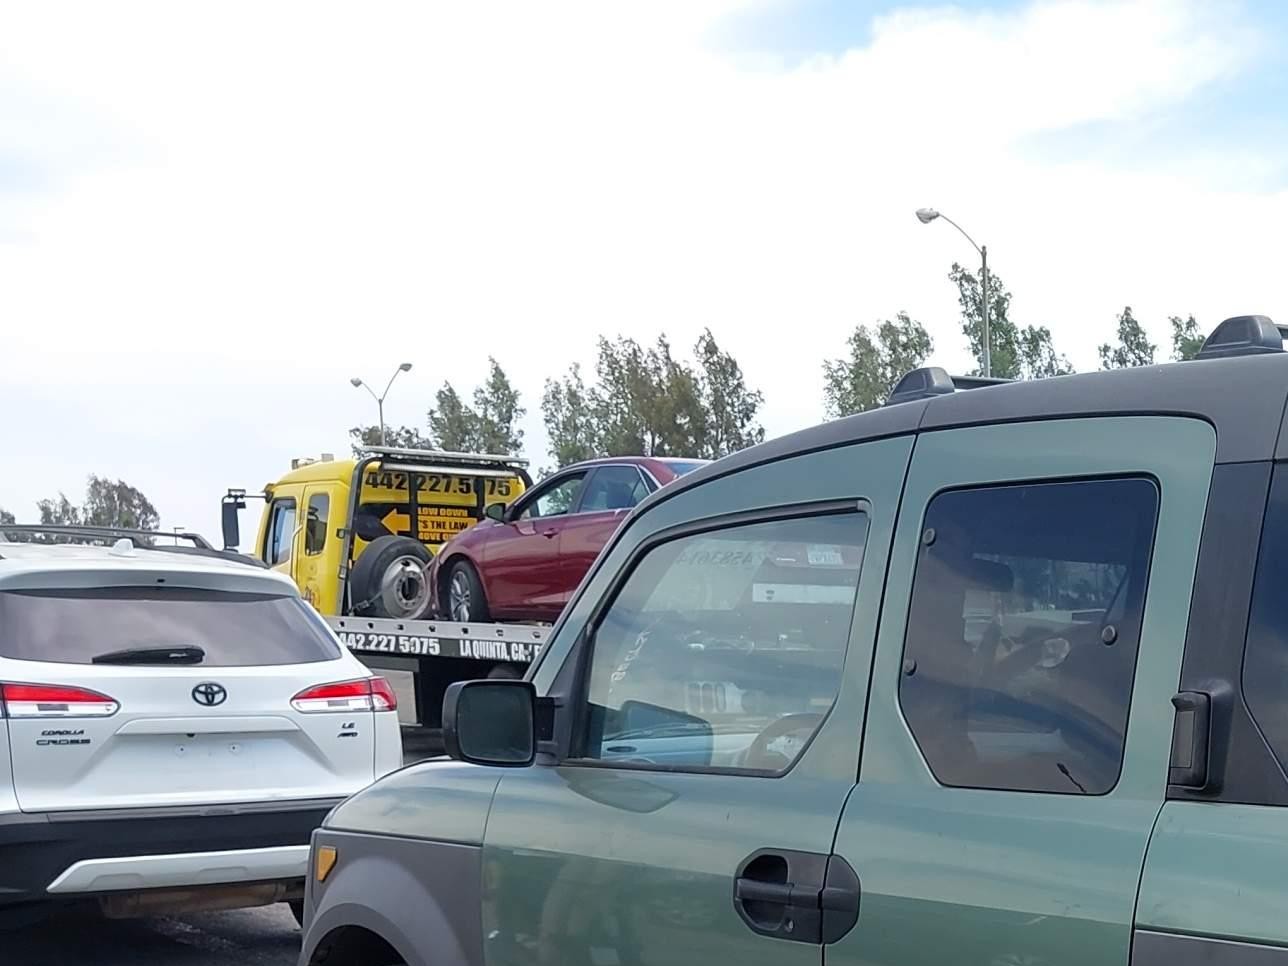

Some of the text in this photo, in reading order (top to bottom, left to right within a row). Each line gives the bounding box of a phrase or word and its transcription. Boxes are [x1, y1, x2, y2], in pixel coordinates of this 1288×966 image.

[431, 520, 447, 529] THE
[449, 521, 468, 530] LAW
[459, 640, 472, 657] LA
[36, 738, 91, 746] CROSS
